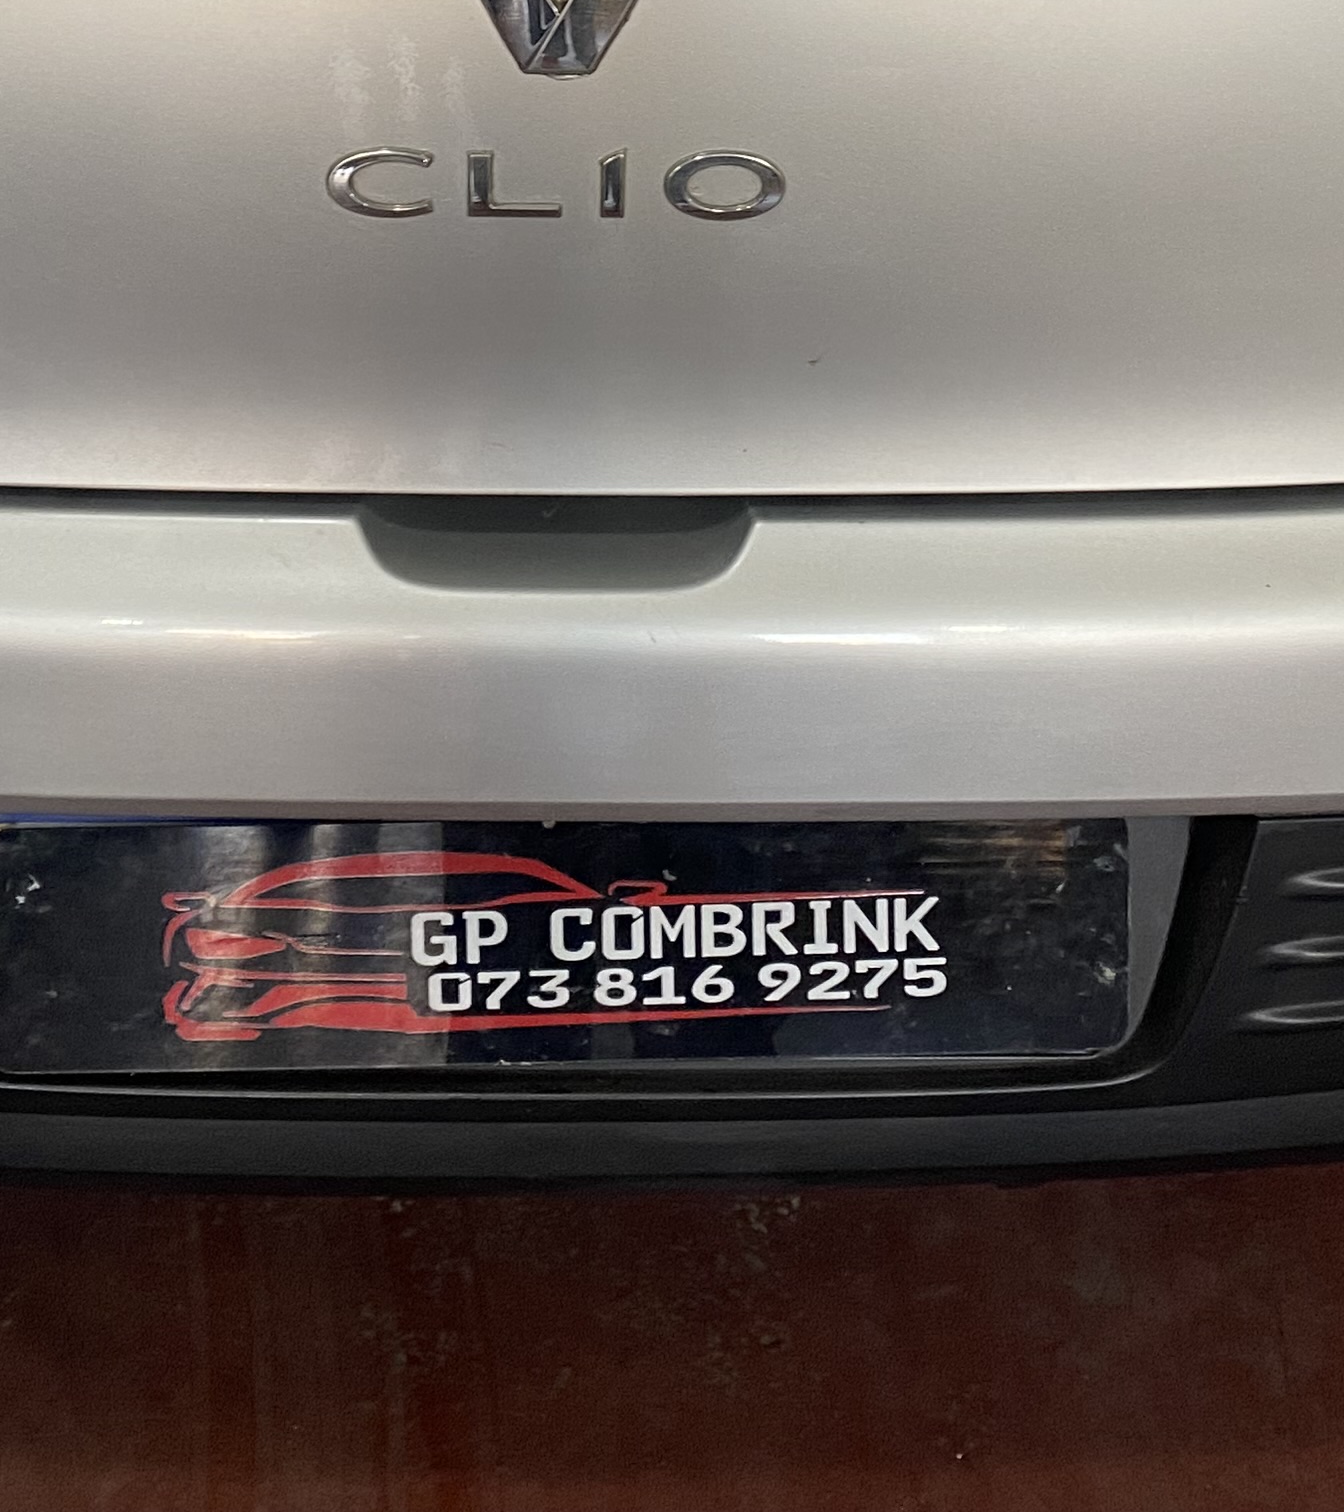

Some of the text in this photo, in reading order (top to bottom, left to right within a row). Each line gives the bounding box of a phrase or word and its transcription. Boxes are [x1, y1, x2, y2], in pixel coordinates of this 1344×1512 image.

[325, 145, 788, 222] CLIO
[409, 895, 941, 966] GP COMBRINK
[426, 956, 949, 1013] 073 816 9275
